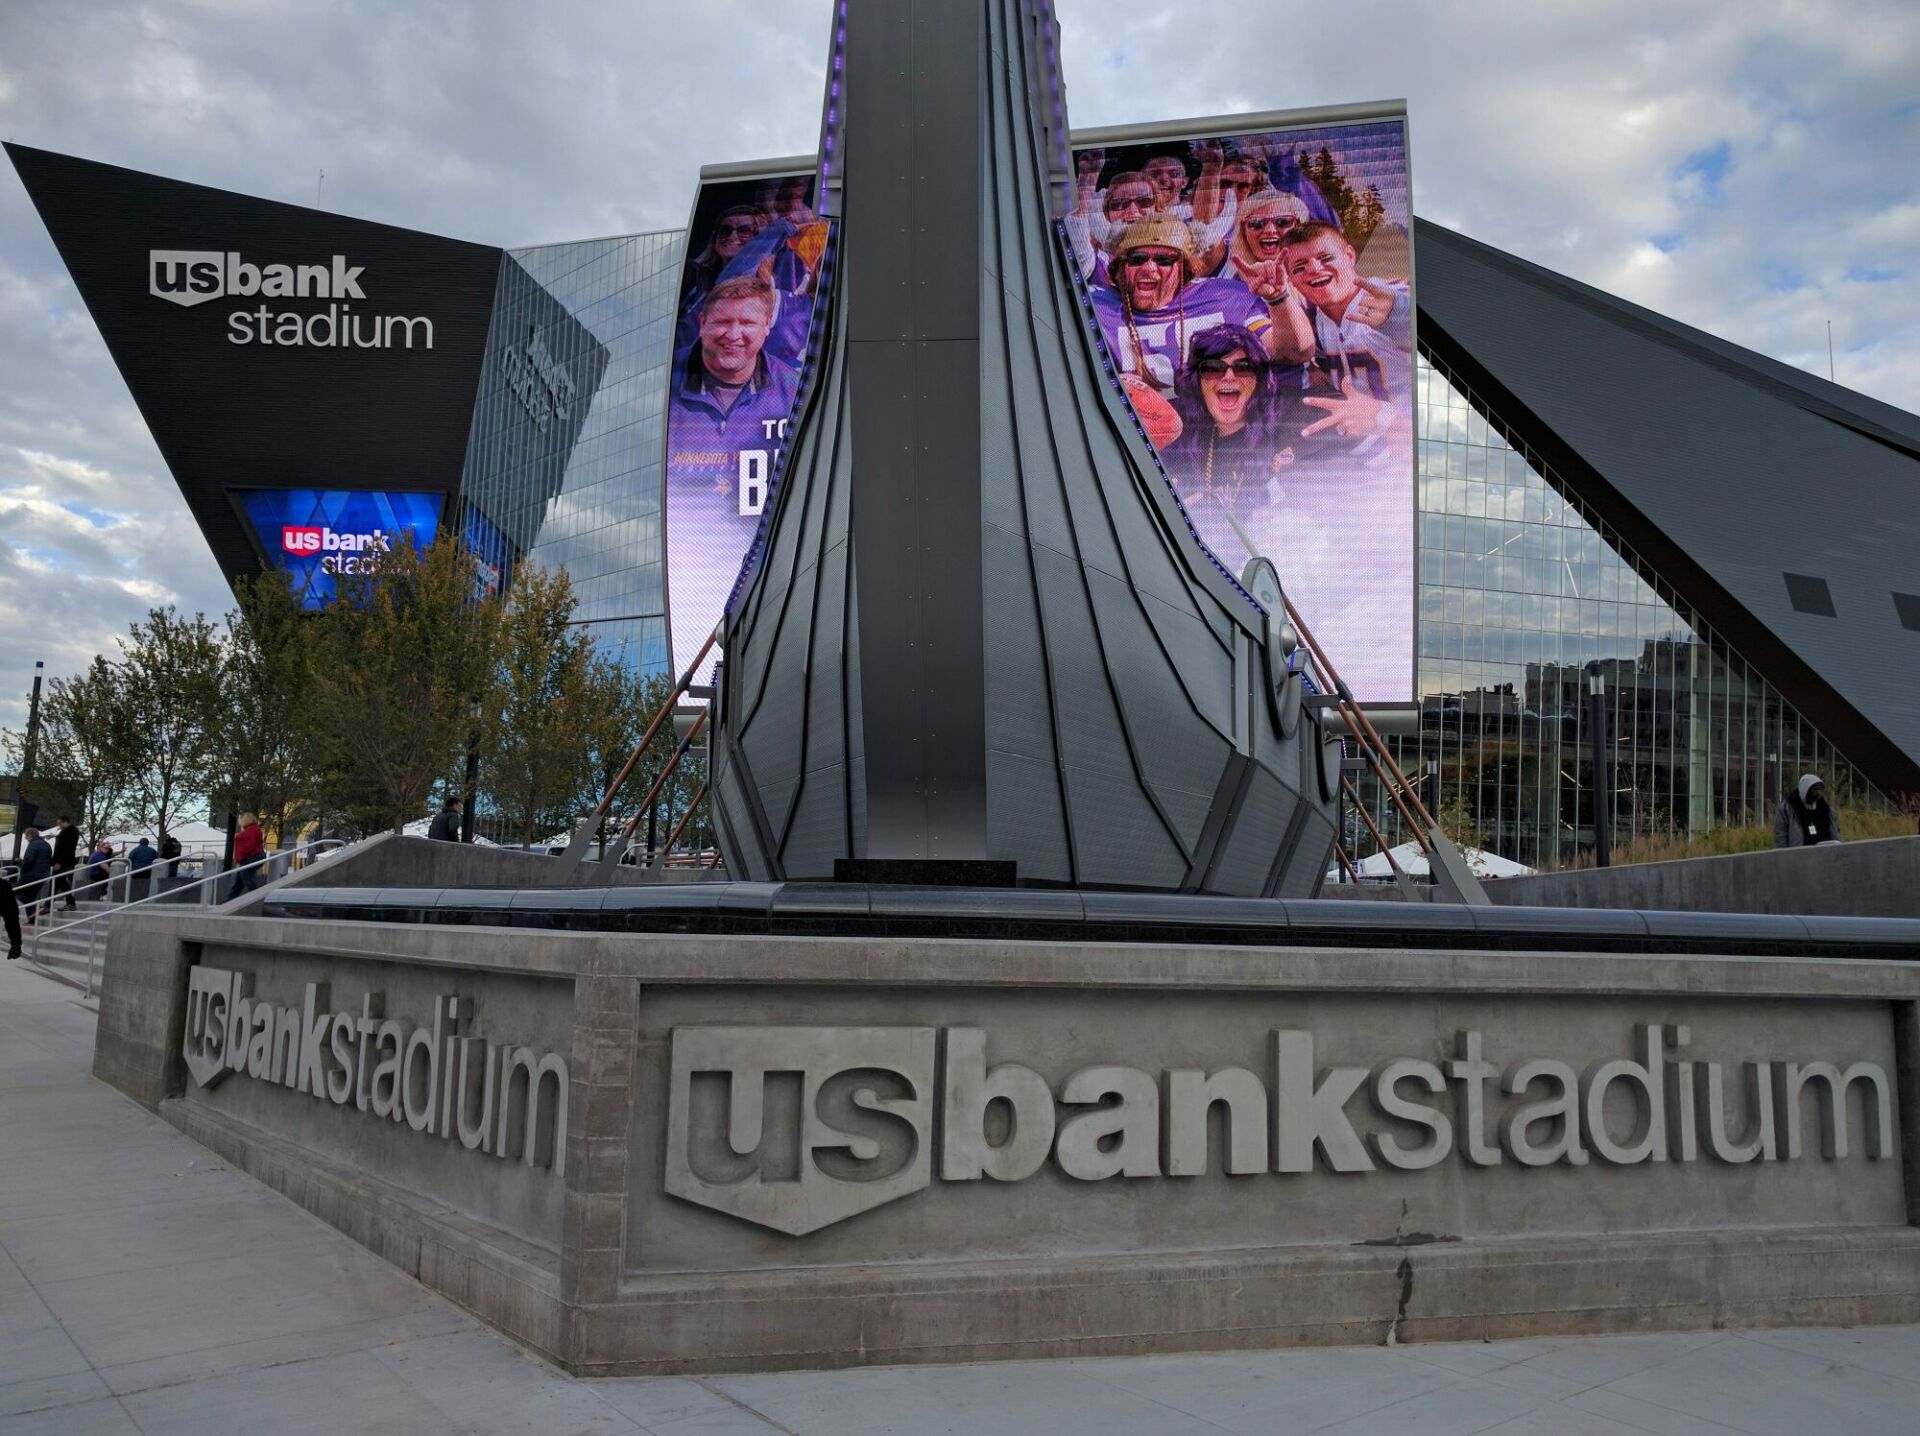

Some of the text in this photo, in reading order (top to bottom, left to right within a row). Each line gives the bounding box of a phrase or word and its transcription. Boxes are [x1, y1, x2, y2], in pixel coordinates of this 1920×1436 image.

[227, 303, 433, 349] stadium
[328, 992, 570, 1178] stadium
[1368, 1023, 1893, 1171] stadium
